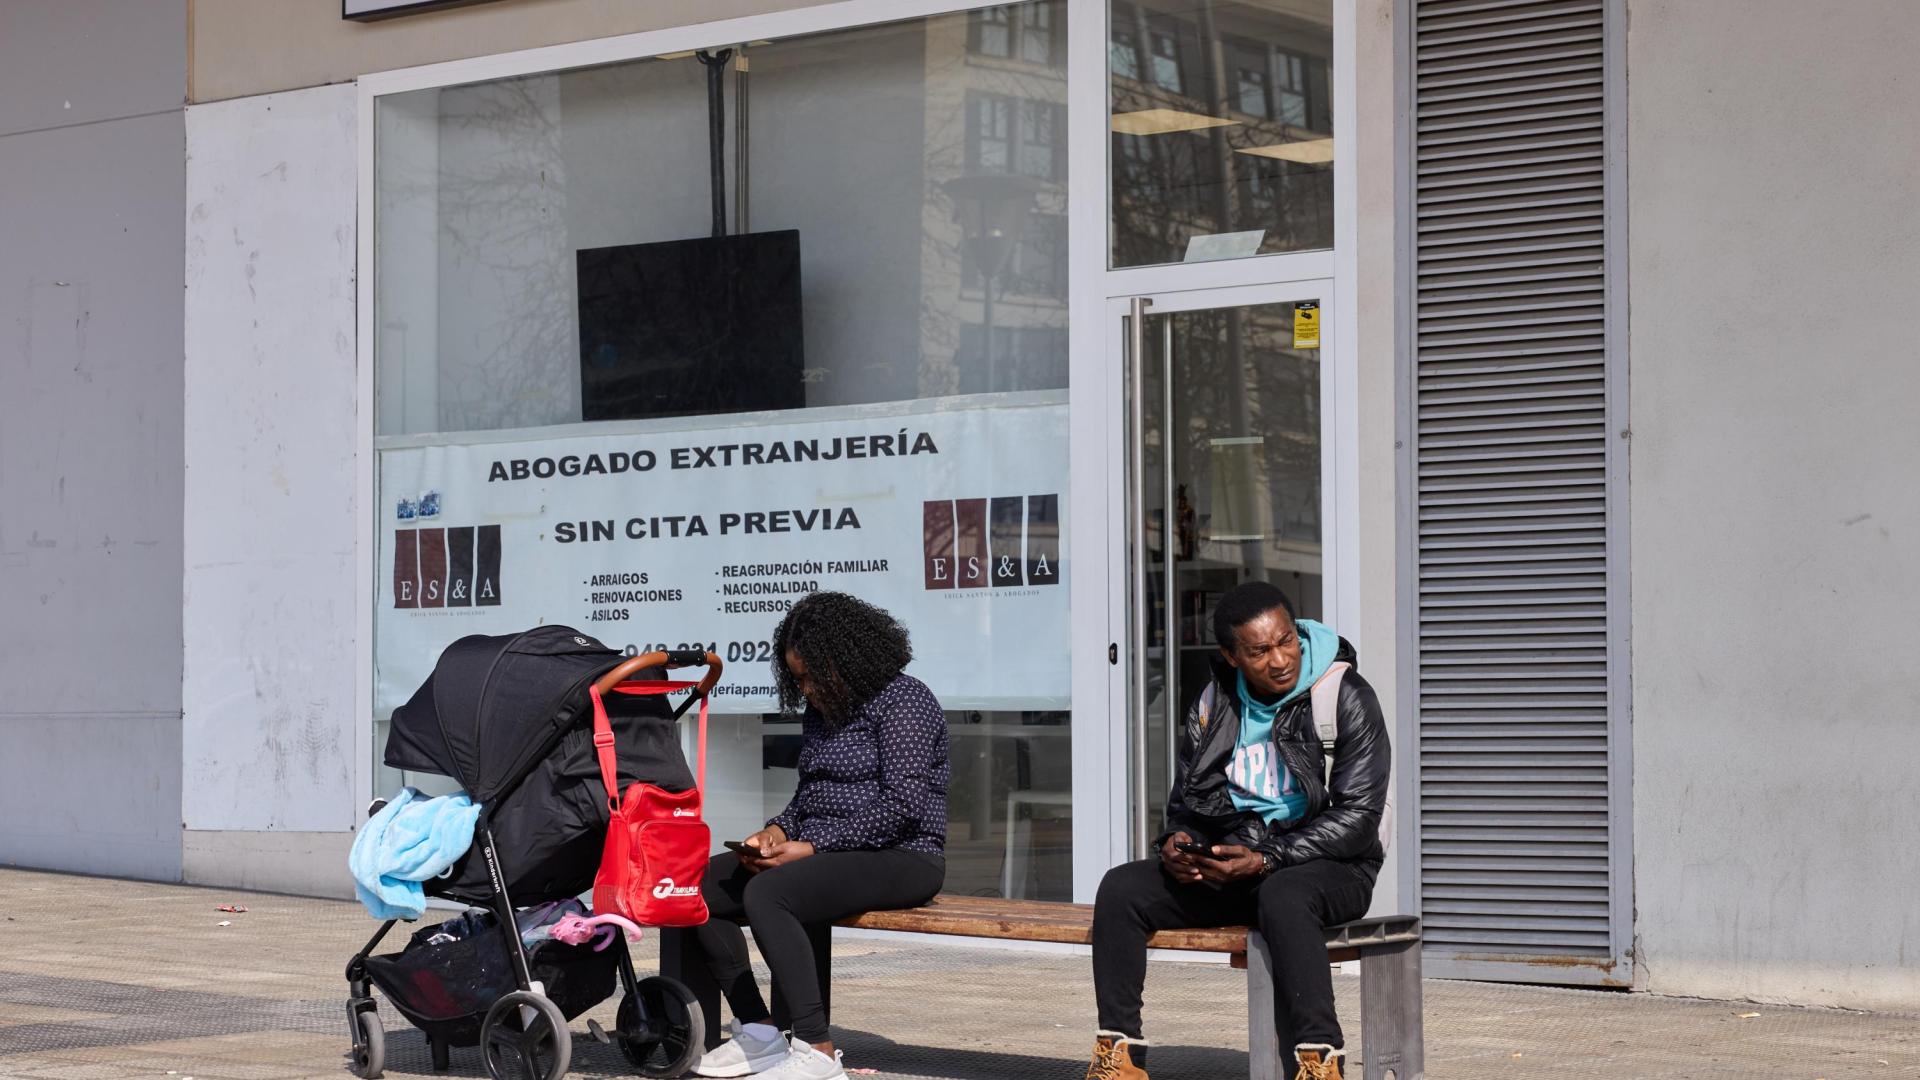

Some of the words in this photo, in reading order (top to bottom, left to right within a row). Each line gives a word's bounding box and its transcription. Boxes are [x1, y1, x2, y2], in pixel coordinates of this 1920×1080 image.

[488, 450, 656, 482] ABOGADO
[670, 428, 939, 470] EXTRANJERÍA
[554, 520, 615, 543] SIN
[625, 515, 709, 540] CITA
[719, 507, 861, 535] PREVIA
[722, 560, 823, 578] REAGRUPACIÓN
[827, 559, 889, 574] FAMILIAR
[590, 572, 649, 587] ARRAIGOS
[723, 580, 818, 596] NACIONALIDAD
[591, 589, 683, 604] RENOVACIONES
[725, 599, 792, 614] RECURSOS
[591, 608, 630, 622] ASILOS
